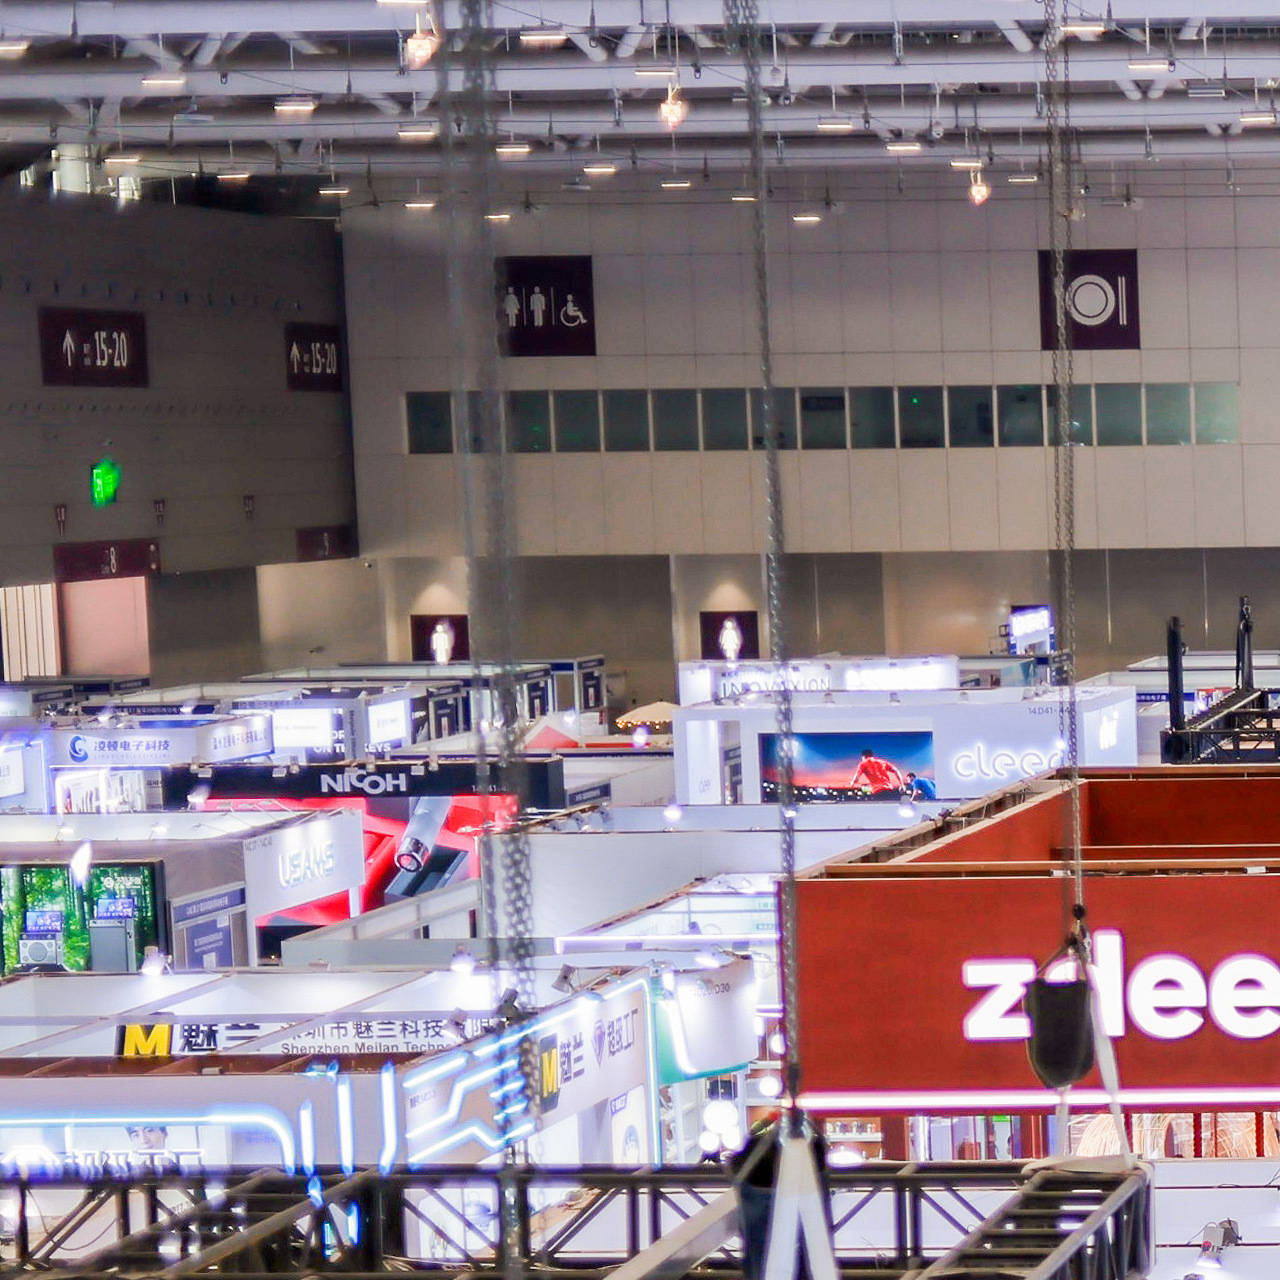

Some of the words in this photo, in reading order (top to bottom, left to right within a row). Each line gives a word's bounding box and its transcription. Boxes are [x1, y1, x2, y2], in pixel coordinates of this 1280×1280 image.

[94, 331, 128, 367] 15-20
[281, 1043, 350, 1055] Shenzhen
[355, 1042, 399, 1053] Meilan
